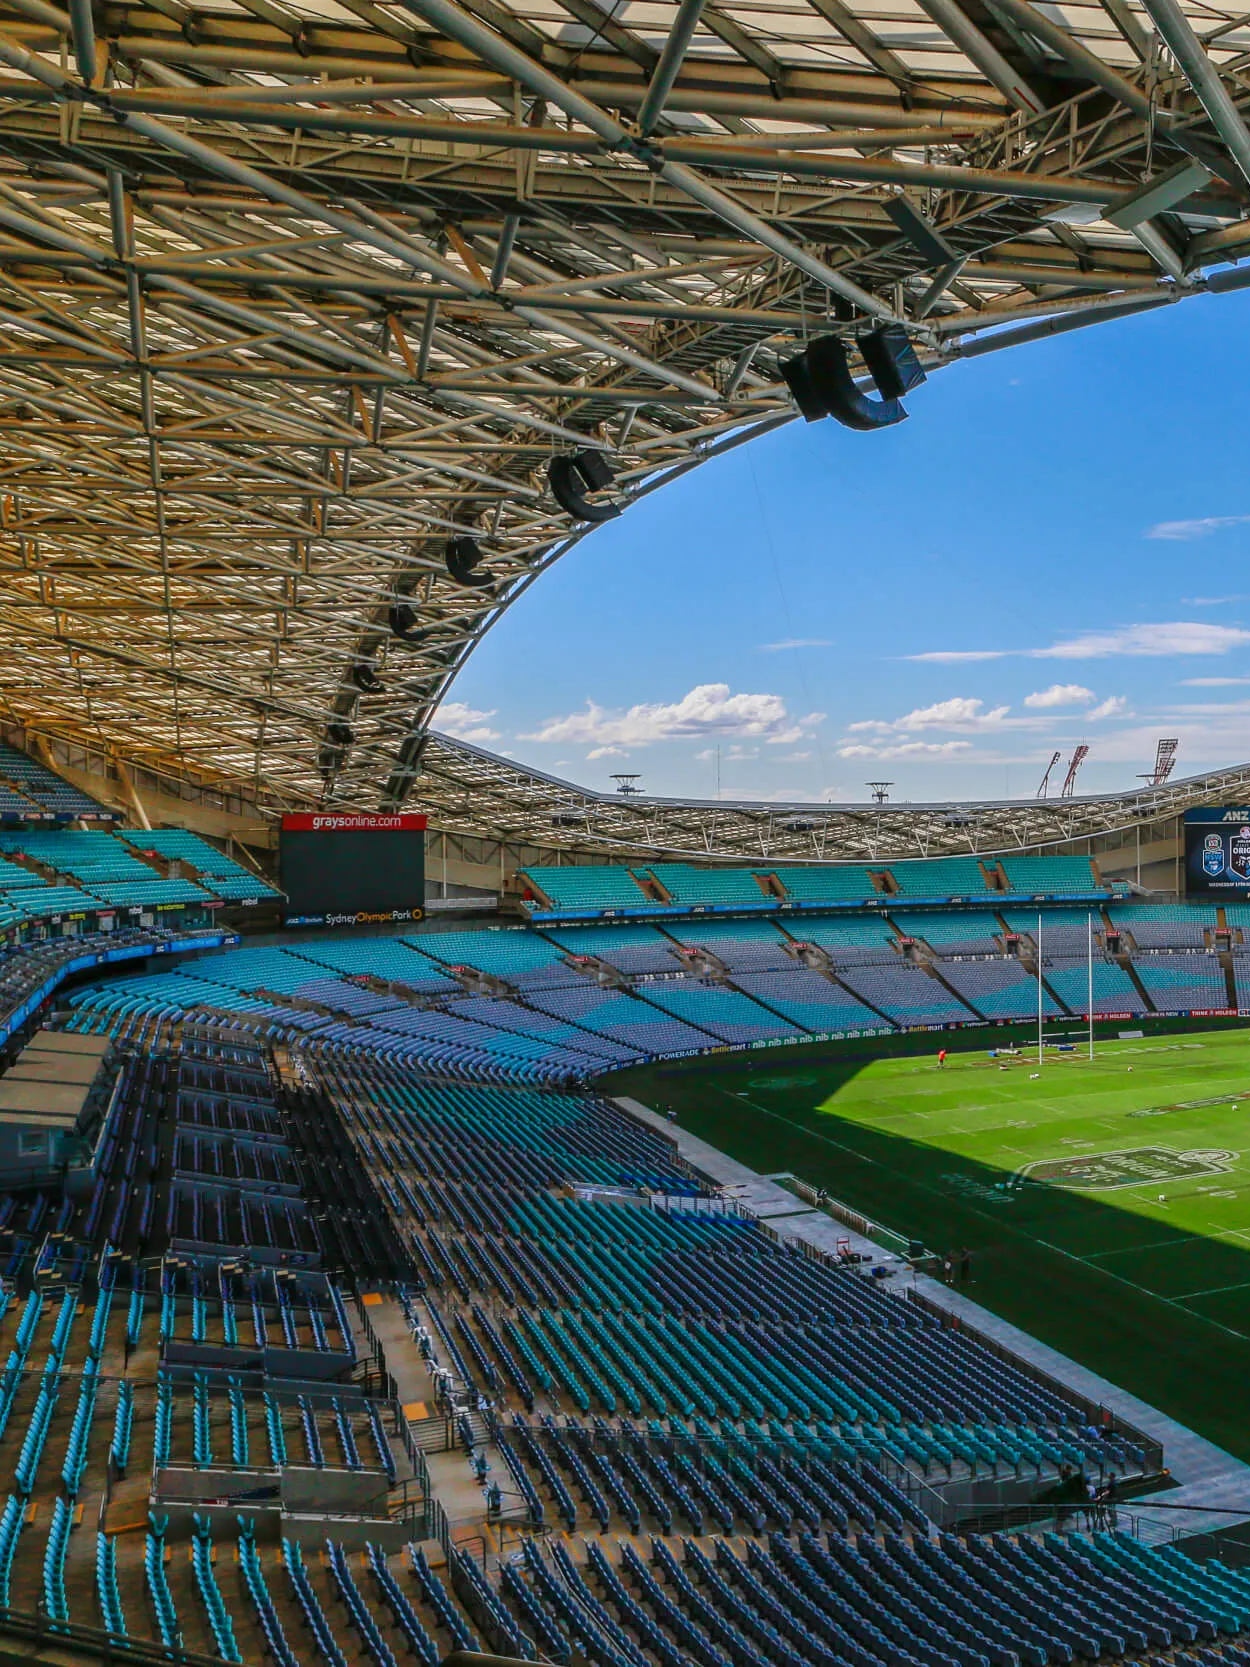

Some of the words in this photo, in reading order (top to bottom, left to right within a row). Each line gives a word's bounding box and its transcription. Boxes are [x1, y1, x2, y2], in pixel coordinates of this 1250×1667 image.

[312, 814, 402, 829] graysonline.com
[1222, 810, 1249, 821] ANZ
[752, 1040, 766, 1048] nib
[768, 1038, 782, 1047] nib
[784, 1036, 798, 1045] nib
[800, 1034, 813, 1043] nib
[816, 1033, 828, 1042] nib
[832, 1032, 844, 1040] nib
[848, 1030, 860, 1038] nib
[863, 1028, 876, 1036] nib
